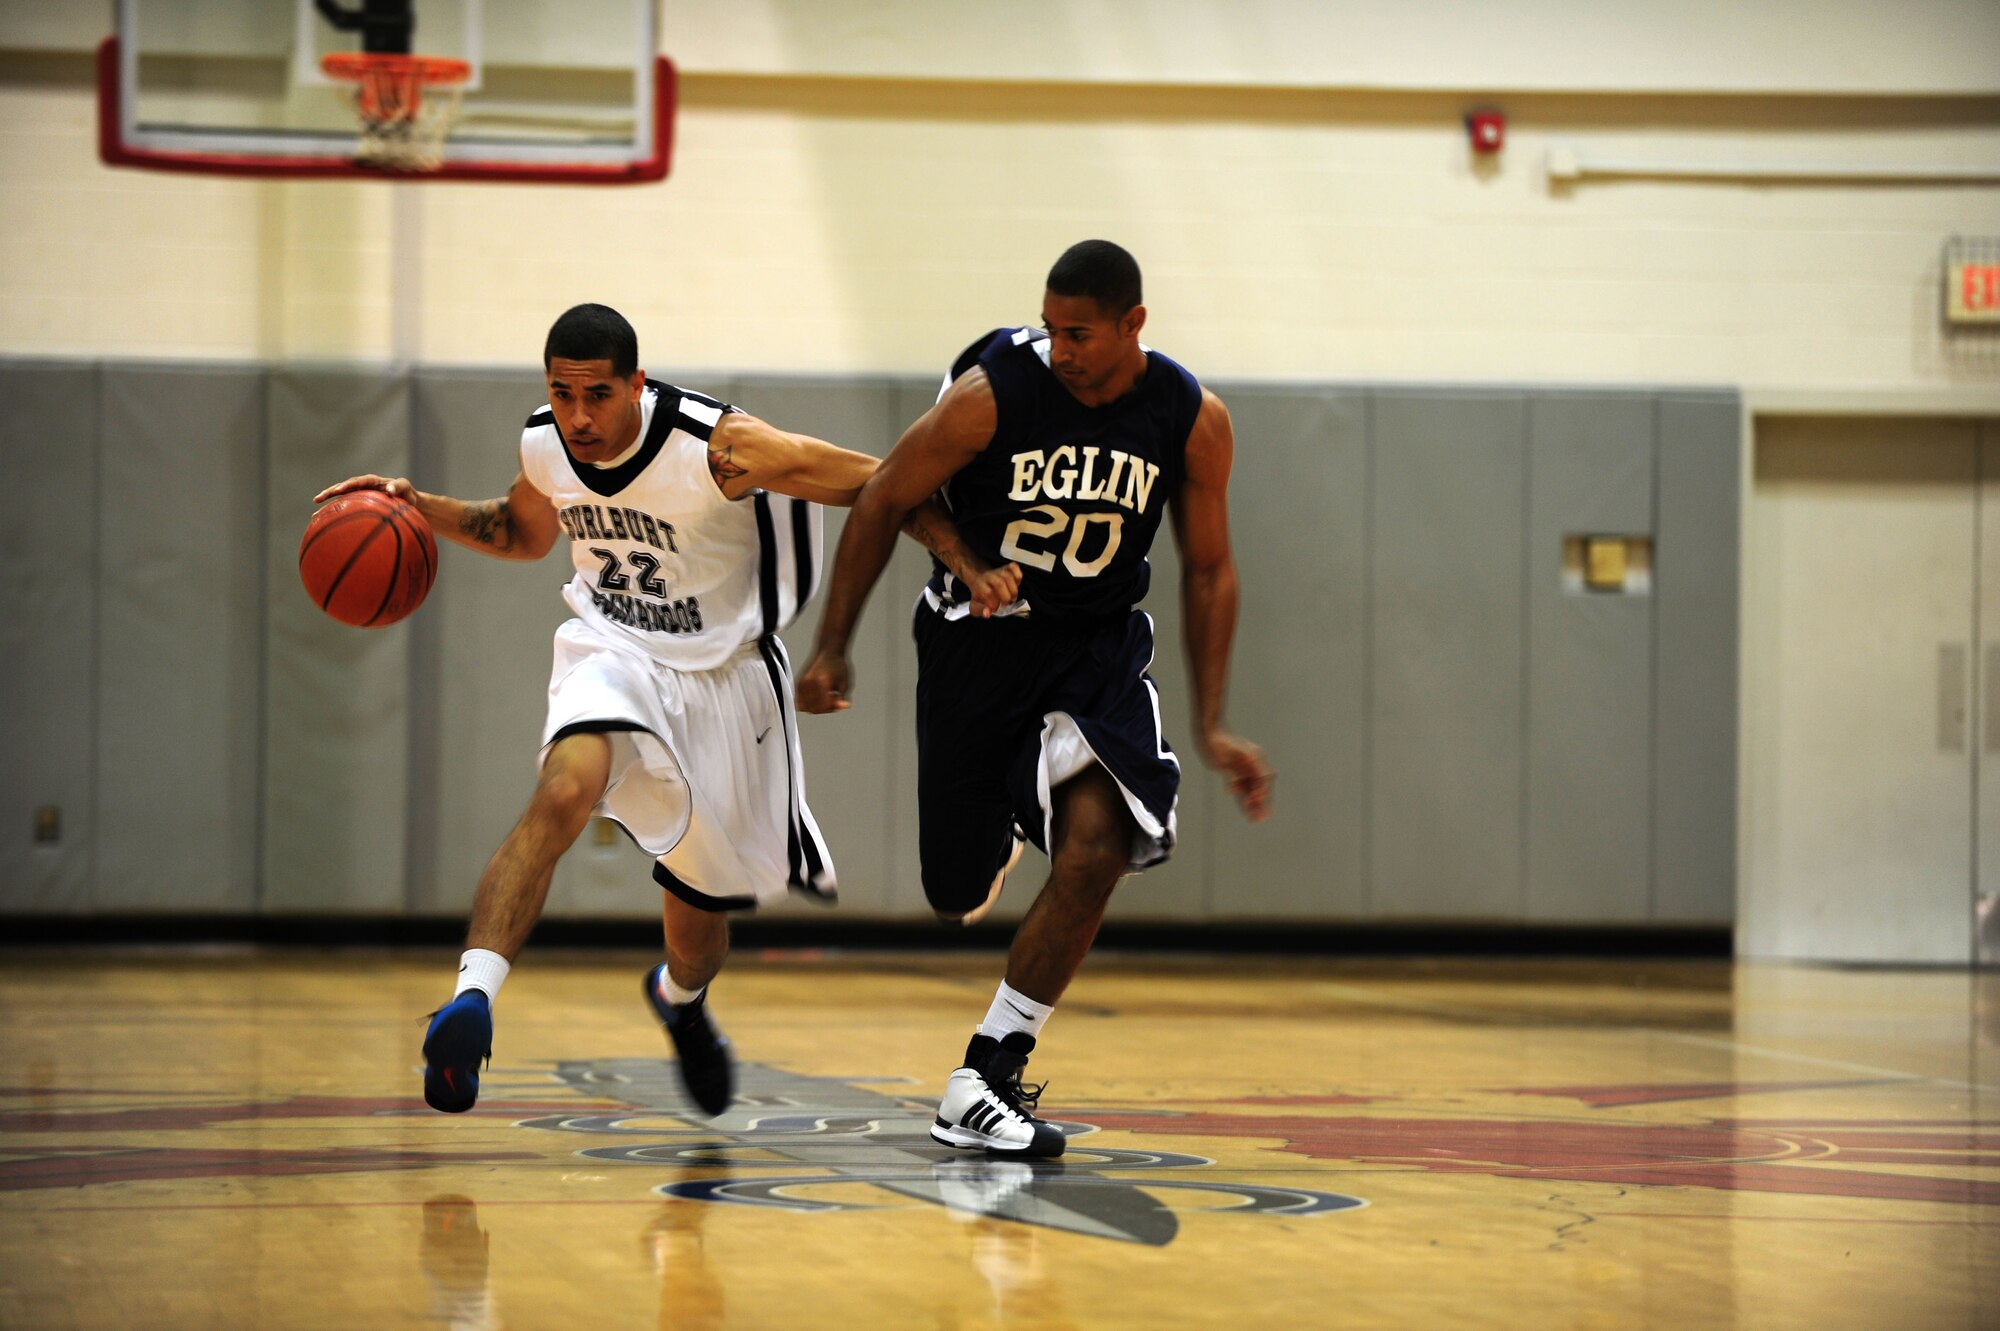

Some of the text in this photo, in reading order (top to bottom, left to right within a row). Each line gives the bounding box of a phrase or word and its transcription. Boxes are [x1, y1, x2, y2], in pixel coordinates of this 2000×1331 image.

[1008, 445, 1160, 514] EGLIN
[589, 546, 667, 599] 22
[1000, 504, 1125, 577] 20
